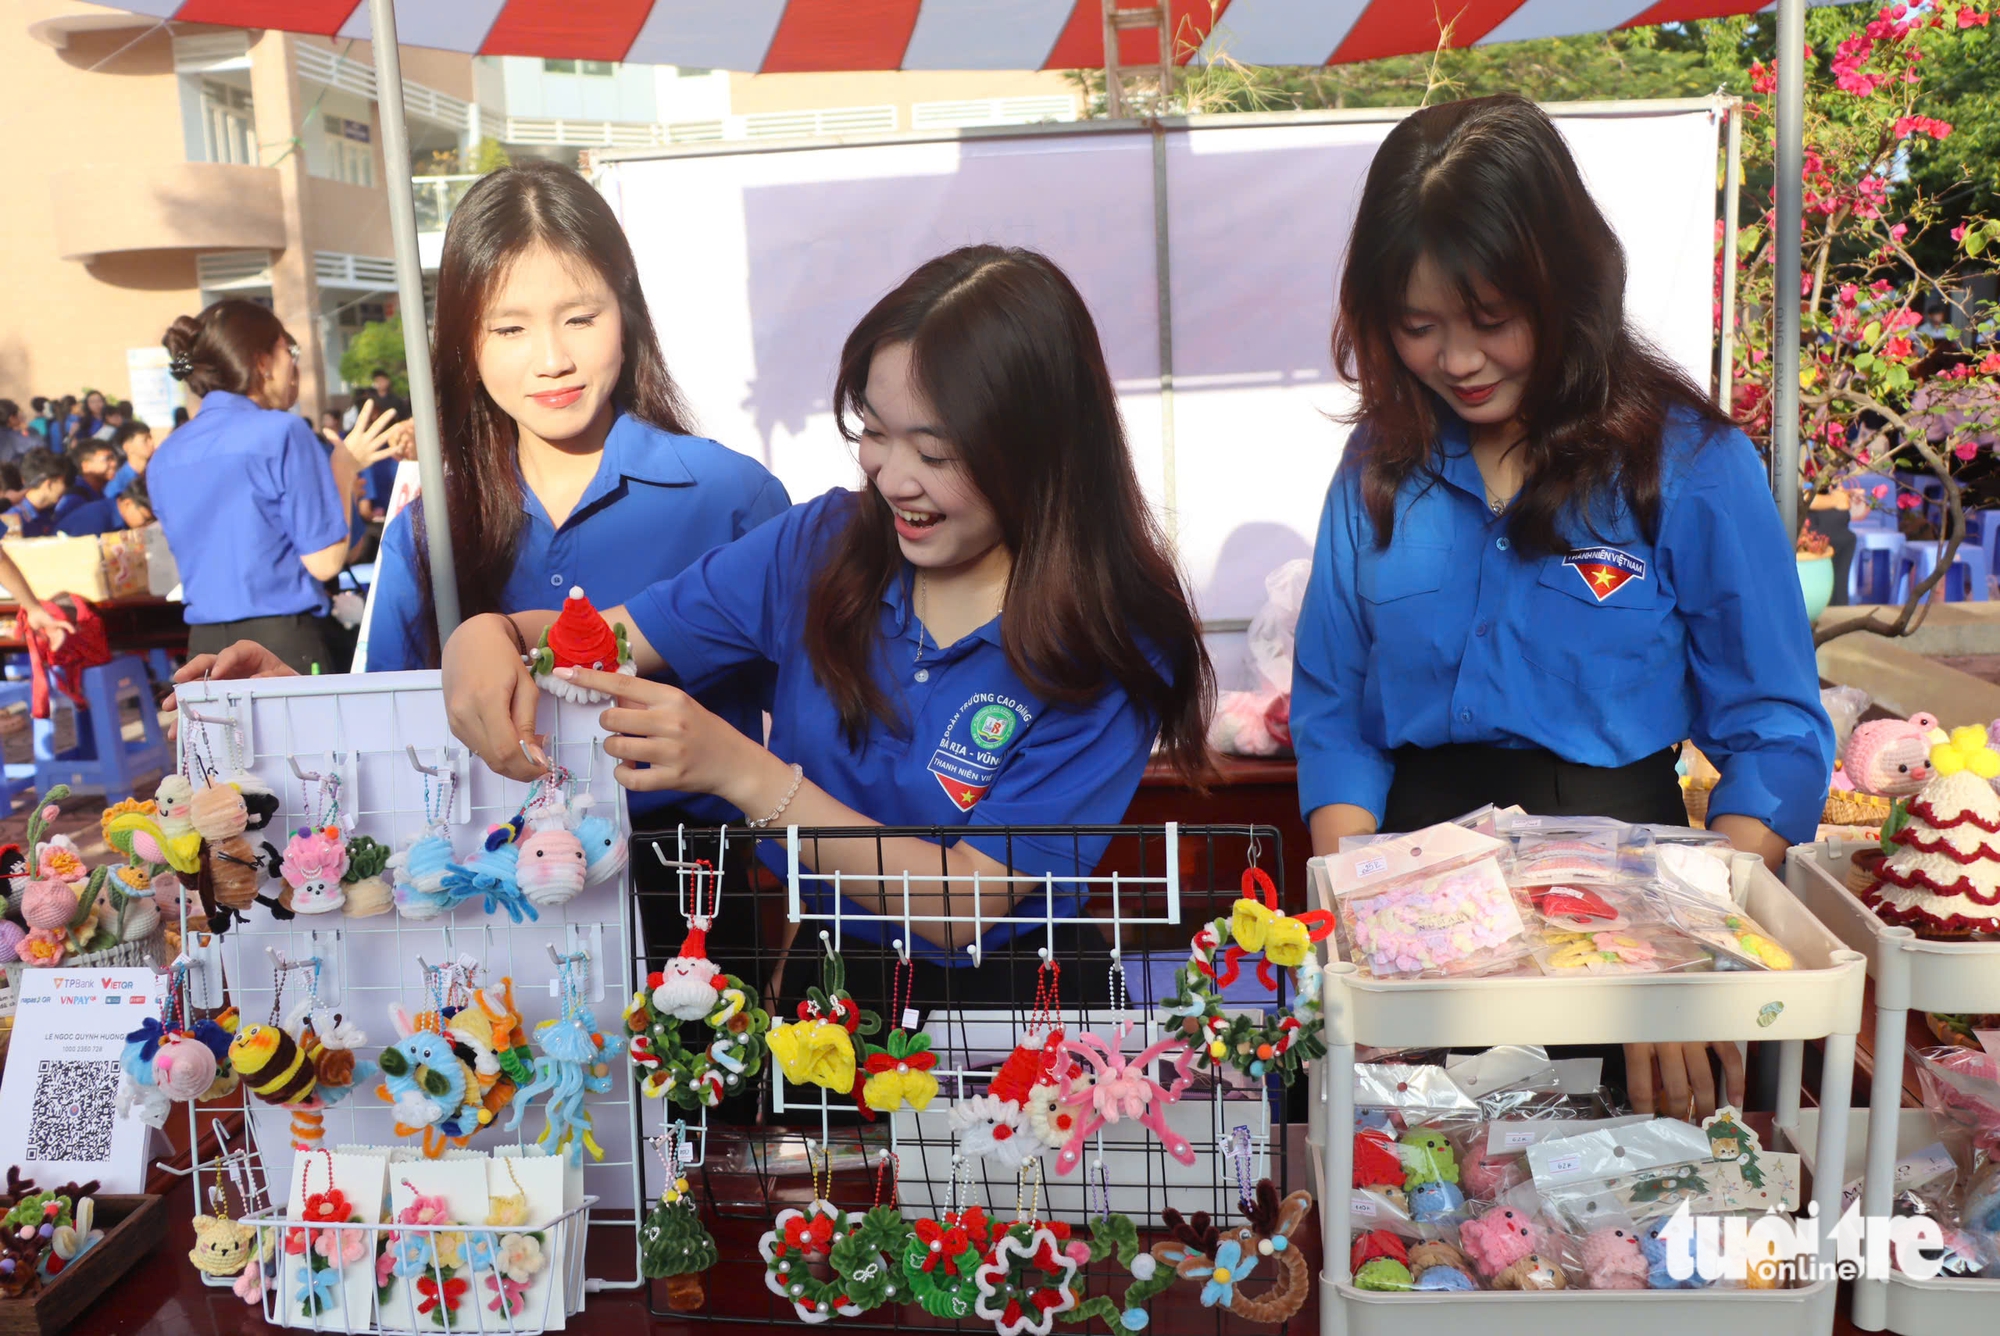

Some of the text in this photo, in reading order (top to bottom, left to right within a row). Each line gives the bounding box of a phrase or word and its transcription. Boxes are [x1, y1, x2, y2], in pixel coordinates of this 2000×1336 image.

[1626, 560, 1643, 573] NAM
[960, 692, 994, 713] TRƯỜNG
[996, 694, 1016, 708] CAO
[939, 736, 950, 749] BÀ
[949, 741, 967, 756] RỊA
[933, 757, 957, 773] THANH
[958, 768, 978, 780] NIÊN
[65, 979, 94, 988] TPBank
[54, 1033, 74, 1041] NGOC
[75, 1033, 98, 1041] QUYNH
[100, 1033, 125, 1041] HUONG
